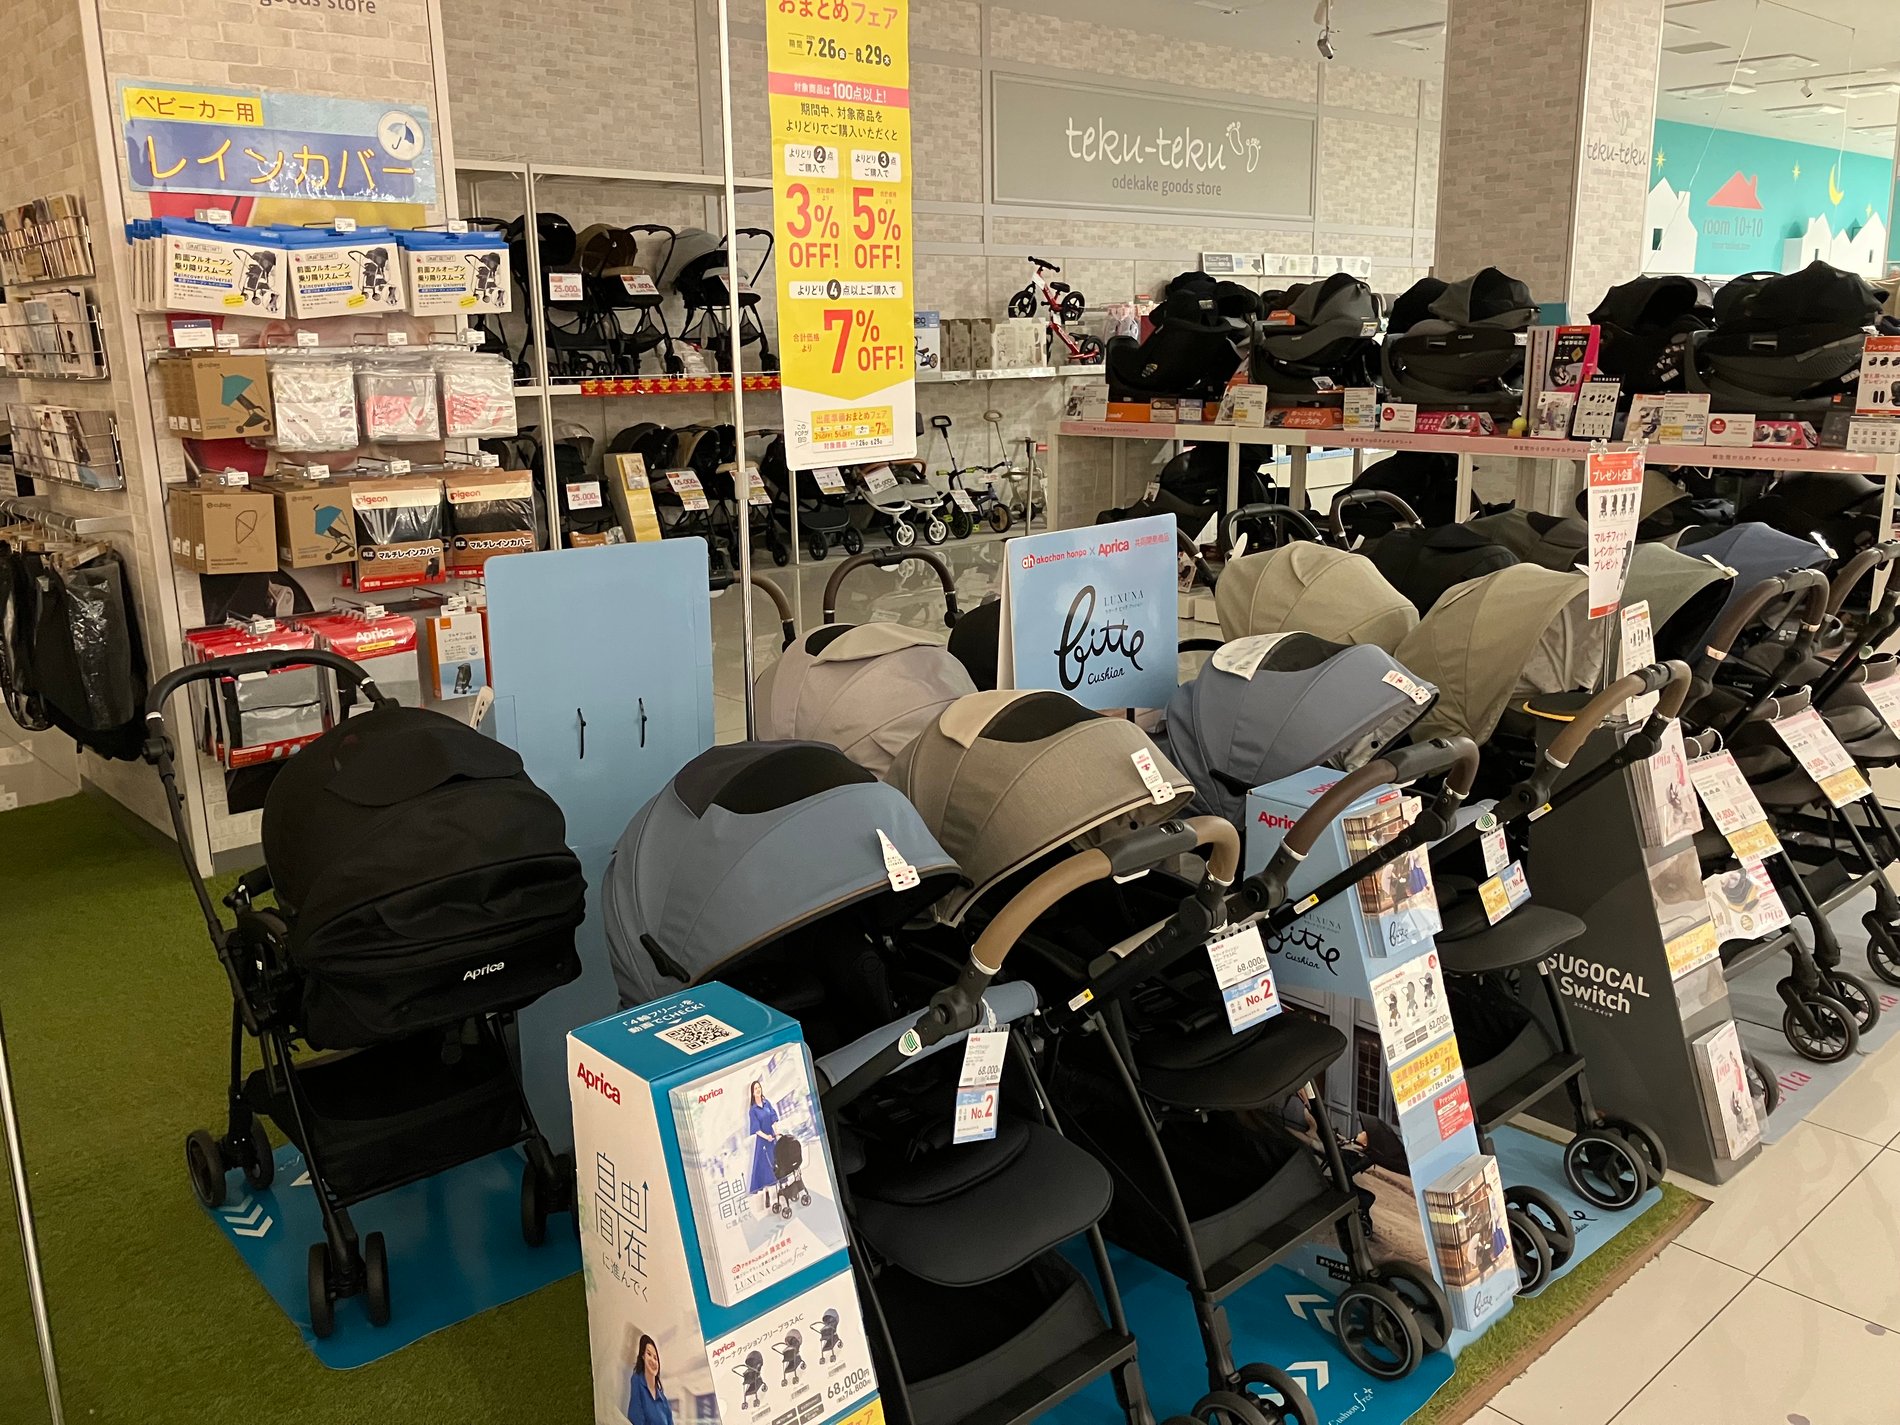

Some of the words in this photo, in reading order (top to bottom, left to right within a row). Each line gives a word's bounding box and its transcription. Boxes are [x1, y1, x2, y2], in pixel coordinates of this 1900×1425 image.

[327, 0, 376, 14] store
[136, 96, 254, 122] ベビーカー用
[800, 102, 883, 123] 期間中、対象商品を
[786, 119, 898, 141] よりどりでご購入いただくと
[1066, 117, 1226, 171] teku-teku
[1586, 137, 1646, 167] teku-teku
[148, 135, 415, 189] レインカバー
[1112, 175, 1158, 192] odekake
[1162, 179, 1193, 196] goods
[1196, 182, 1221, 196] store
[1703, 216, 1730, 235] room
[1734, 217, 1763, 238] 10+10
[789, 242, 839, 268] OFF!
[854, 244, 900, 269] OFF!
[857, 345, 904, 372] OFF!
[1592, 468, 1633, 483] プレゼント企画
[453, 490, 481, 499] pigeon
[378, 547, 440, 559] マルチレインカバー
[470, 538, 531, 549] マルチレインカバー
[1036, 554, 1065, 565] akachan
[1066, 549, 1087, 559] honpo
[1097, 539, 1130, 557] Aprica
[1104, 590, 1145, 607] LUXUNA
[355, 626, 395, 643] Aprica
[1257, 811, 1296, 829] Apric
[463, 962, 505, 981] Aprica
[1547, 952, 1651, 998] SUGOCAL
[1245, 979, 1274, 1007] No.2
[1559, 975, 1631, 1014] Switch
[577, 1062, 621, 1105] Aprica
[698, 1086, 724, 1104] Aprica
[971, 1094, 994, 1119] No.2
[712, 1341, 736, 1358] Aprica
[827, 1368, 870, 1399] 68,000円
